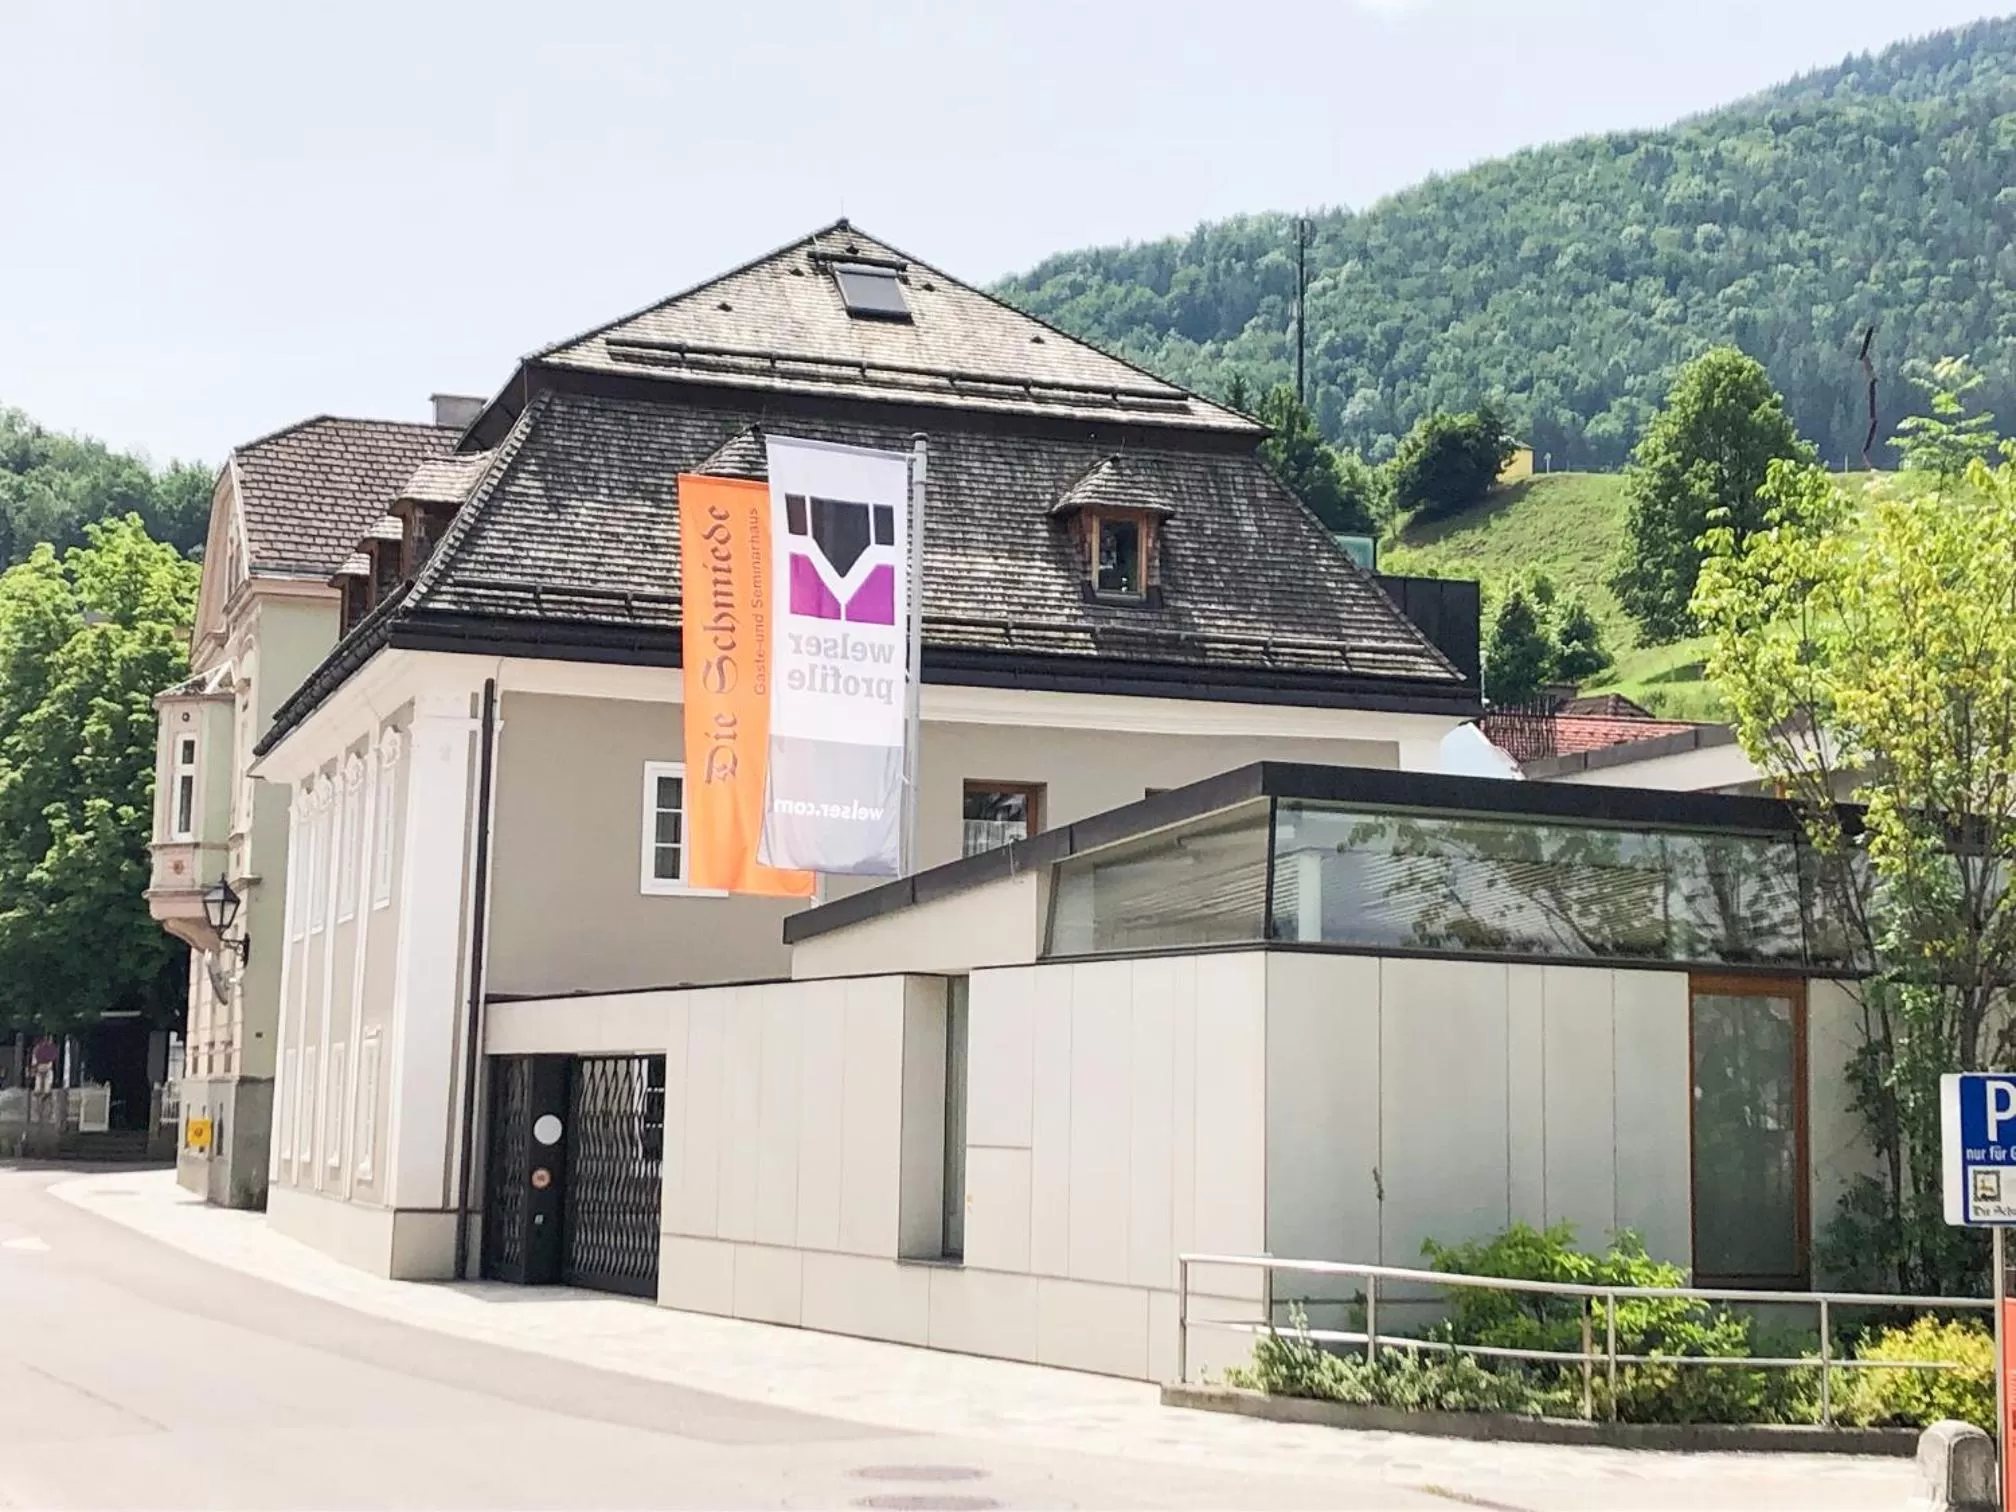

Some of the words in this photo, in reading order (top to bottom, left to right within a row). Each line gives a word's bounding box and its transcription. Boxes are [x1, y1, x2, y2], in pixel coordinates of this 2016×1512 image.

[702, 504, 742, 695] Schmiede
[704, 711, 739, 785] Die
[1986, 1081, 2016, 1142] P
[1966, 1148, 1986, 1161] nur
[1989, 1145, 2007, 1162] für
